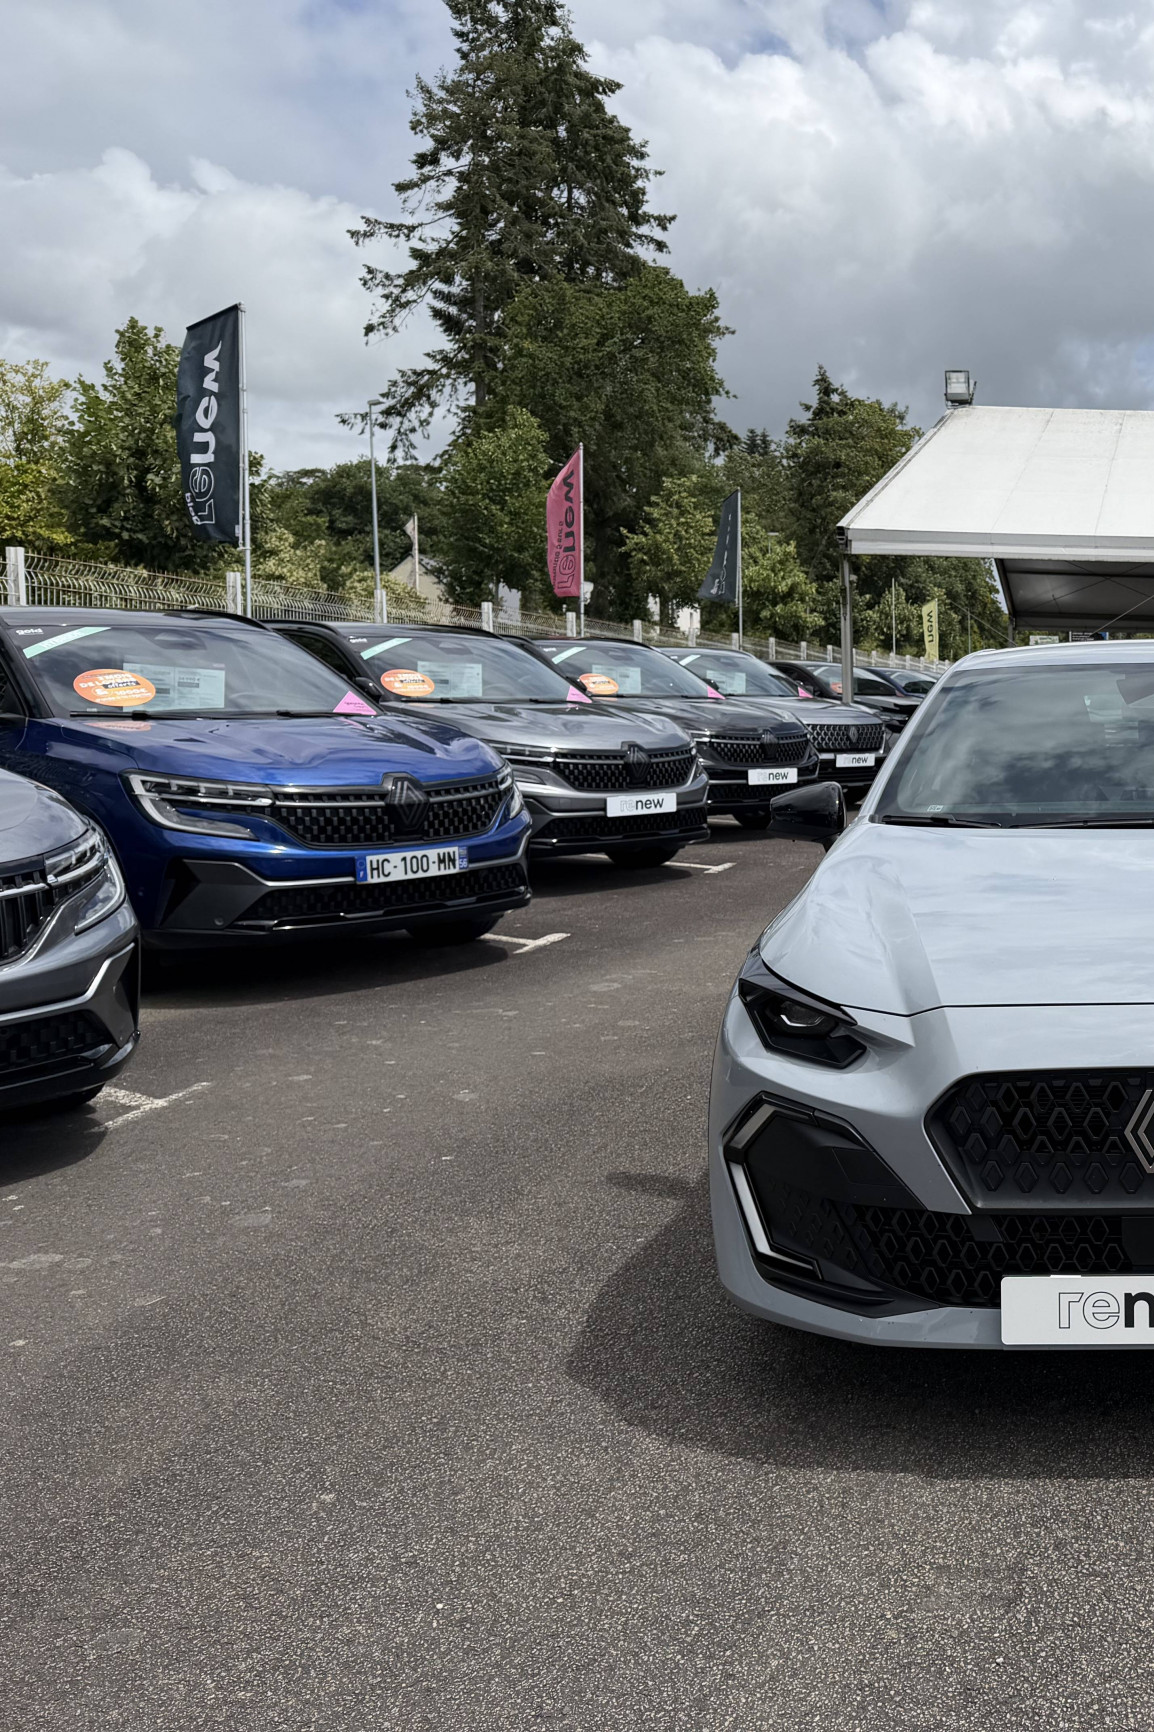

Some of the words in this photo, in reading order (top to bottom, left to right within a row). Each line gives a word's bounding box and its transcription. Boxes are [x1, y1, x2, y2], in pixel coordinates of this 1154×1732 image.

[620, 798, 665, 812] renew
[369, 850, 457, 879] HC-100-MN
[459, 858, 468, 868] 56
